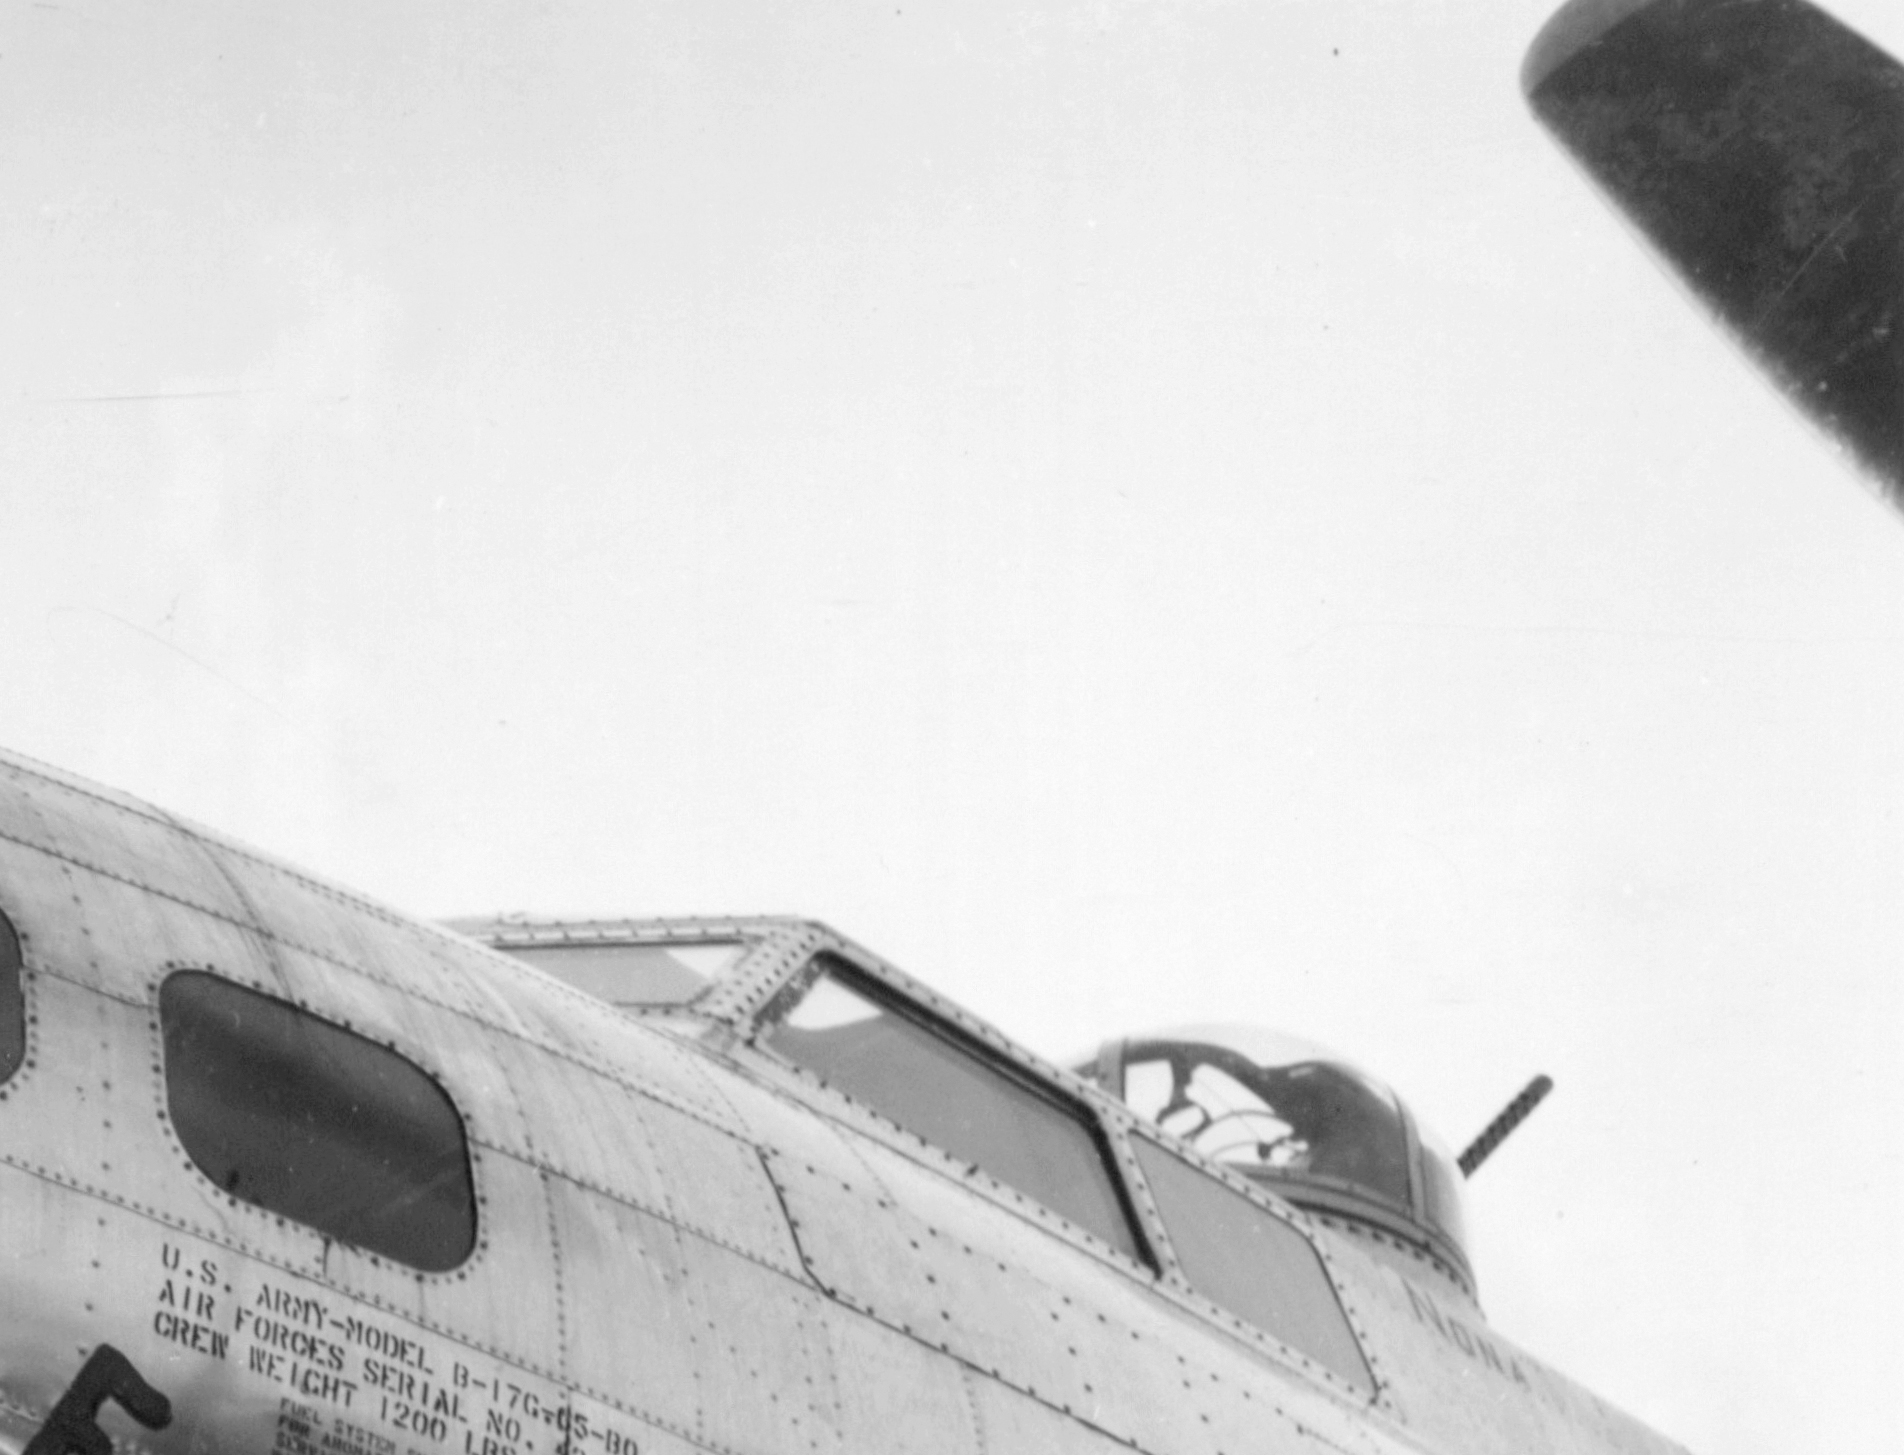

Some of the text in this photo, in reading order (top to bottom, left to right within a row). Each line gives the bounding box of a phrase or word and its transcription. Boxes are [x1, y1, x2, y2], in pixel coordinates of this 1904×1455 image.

[158, 1278, 216, 1322] AIR
[234, 1304, 345, 1372] FORCES
[362, 1357, 469, 1424] SERIAL
[485, 1408, 535, 1452] NO.
[161, 1242, 233, 1294] U.S.
[255, 1283, 434, 1376] ARMY-MODEL
[153, 1310, 230, 1361] CREW
[248, 1344, 359, 1408] WEIGHT
[380, 1395, 448, 1444] 1200
[279, 1396, 322, 1427] FUEL
[333, 1418, 397, 1455] SYSTEM
